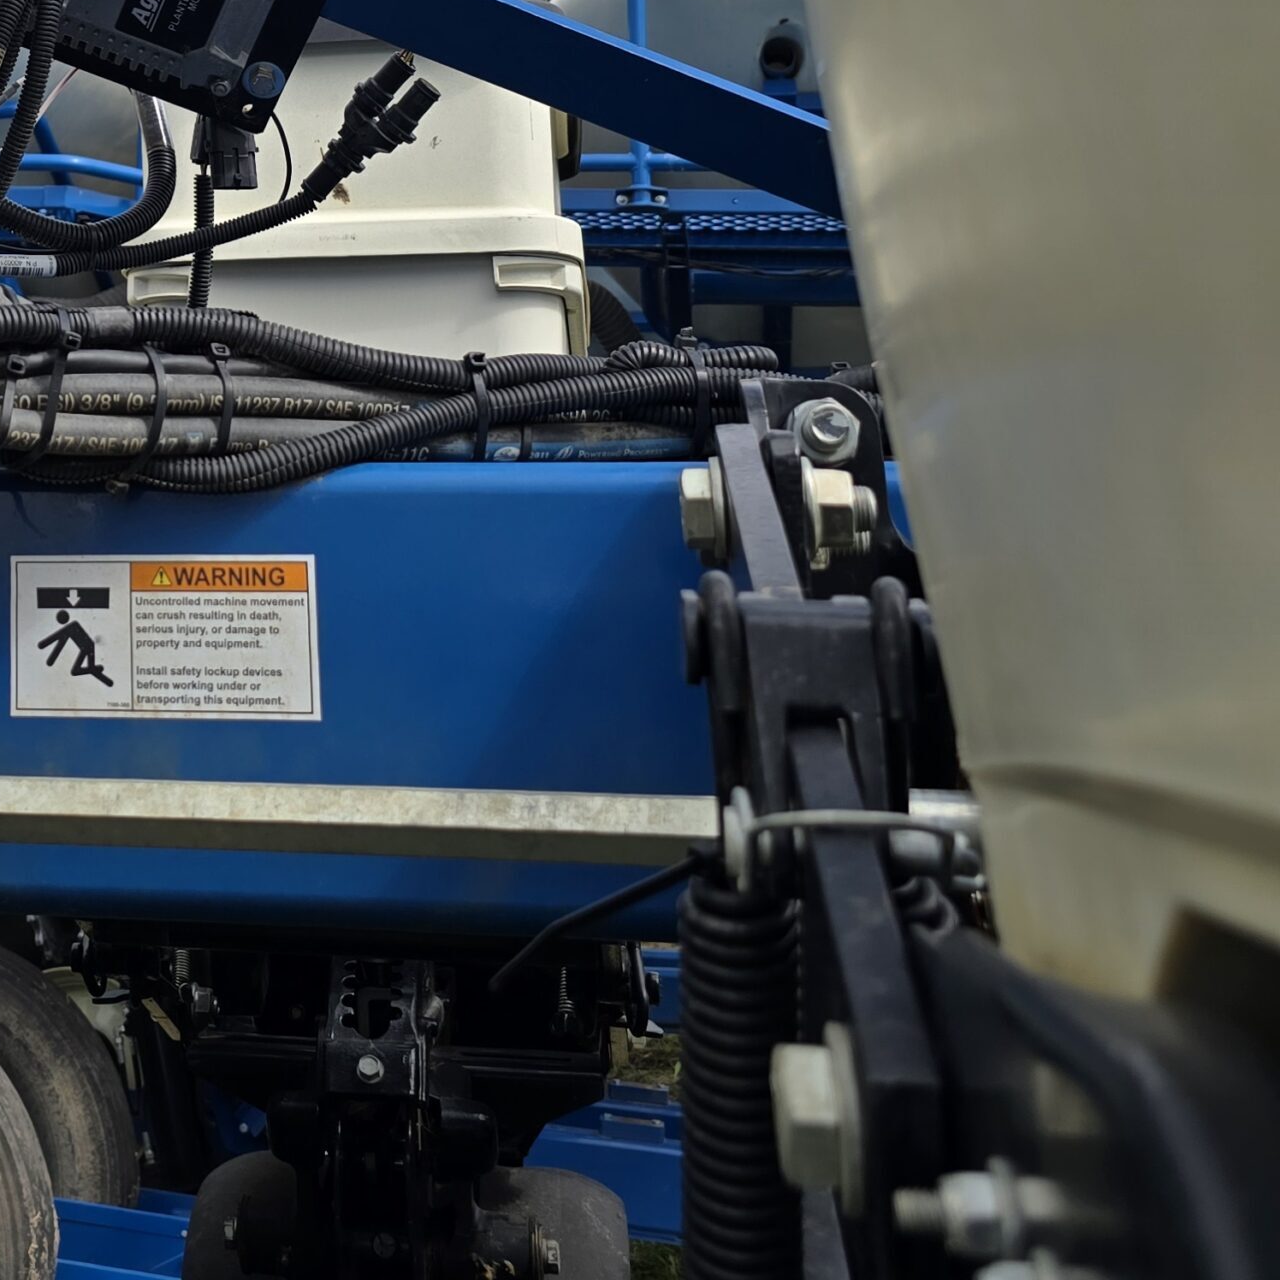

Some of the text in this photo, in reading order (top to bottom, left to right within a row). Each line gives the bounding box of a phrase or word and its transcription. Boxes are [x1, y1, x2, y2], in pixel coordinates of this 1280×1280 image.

[80, 393, 120, 411] 3/8"
[283, 397, 312, 415] R17
[324, 399, 353, 417] SAE
[173, 567, 285, 586] WARNING
[135, 596, 304, 607] Uncontrolled machine movement
[135, 610, 282, 622] can crush resulting in death,
[135, 624, 173, 634] serious
[176, 624, 208, 637] injury,
[225, 625, 266, 637] damage
[269, 625, 279, 635] to
[136, 639, 263, 651] property and equipment.
[136, 666, 282, 679] Install safety lockup devices
[136, 680, 261, 693] before working under or
[137, 695, 201, 707] transporting
[203, 695, 223, 705] this
[226, 695, 285, 708] equipment.
